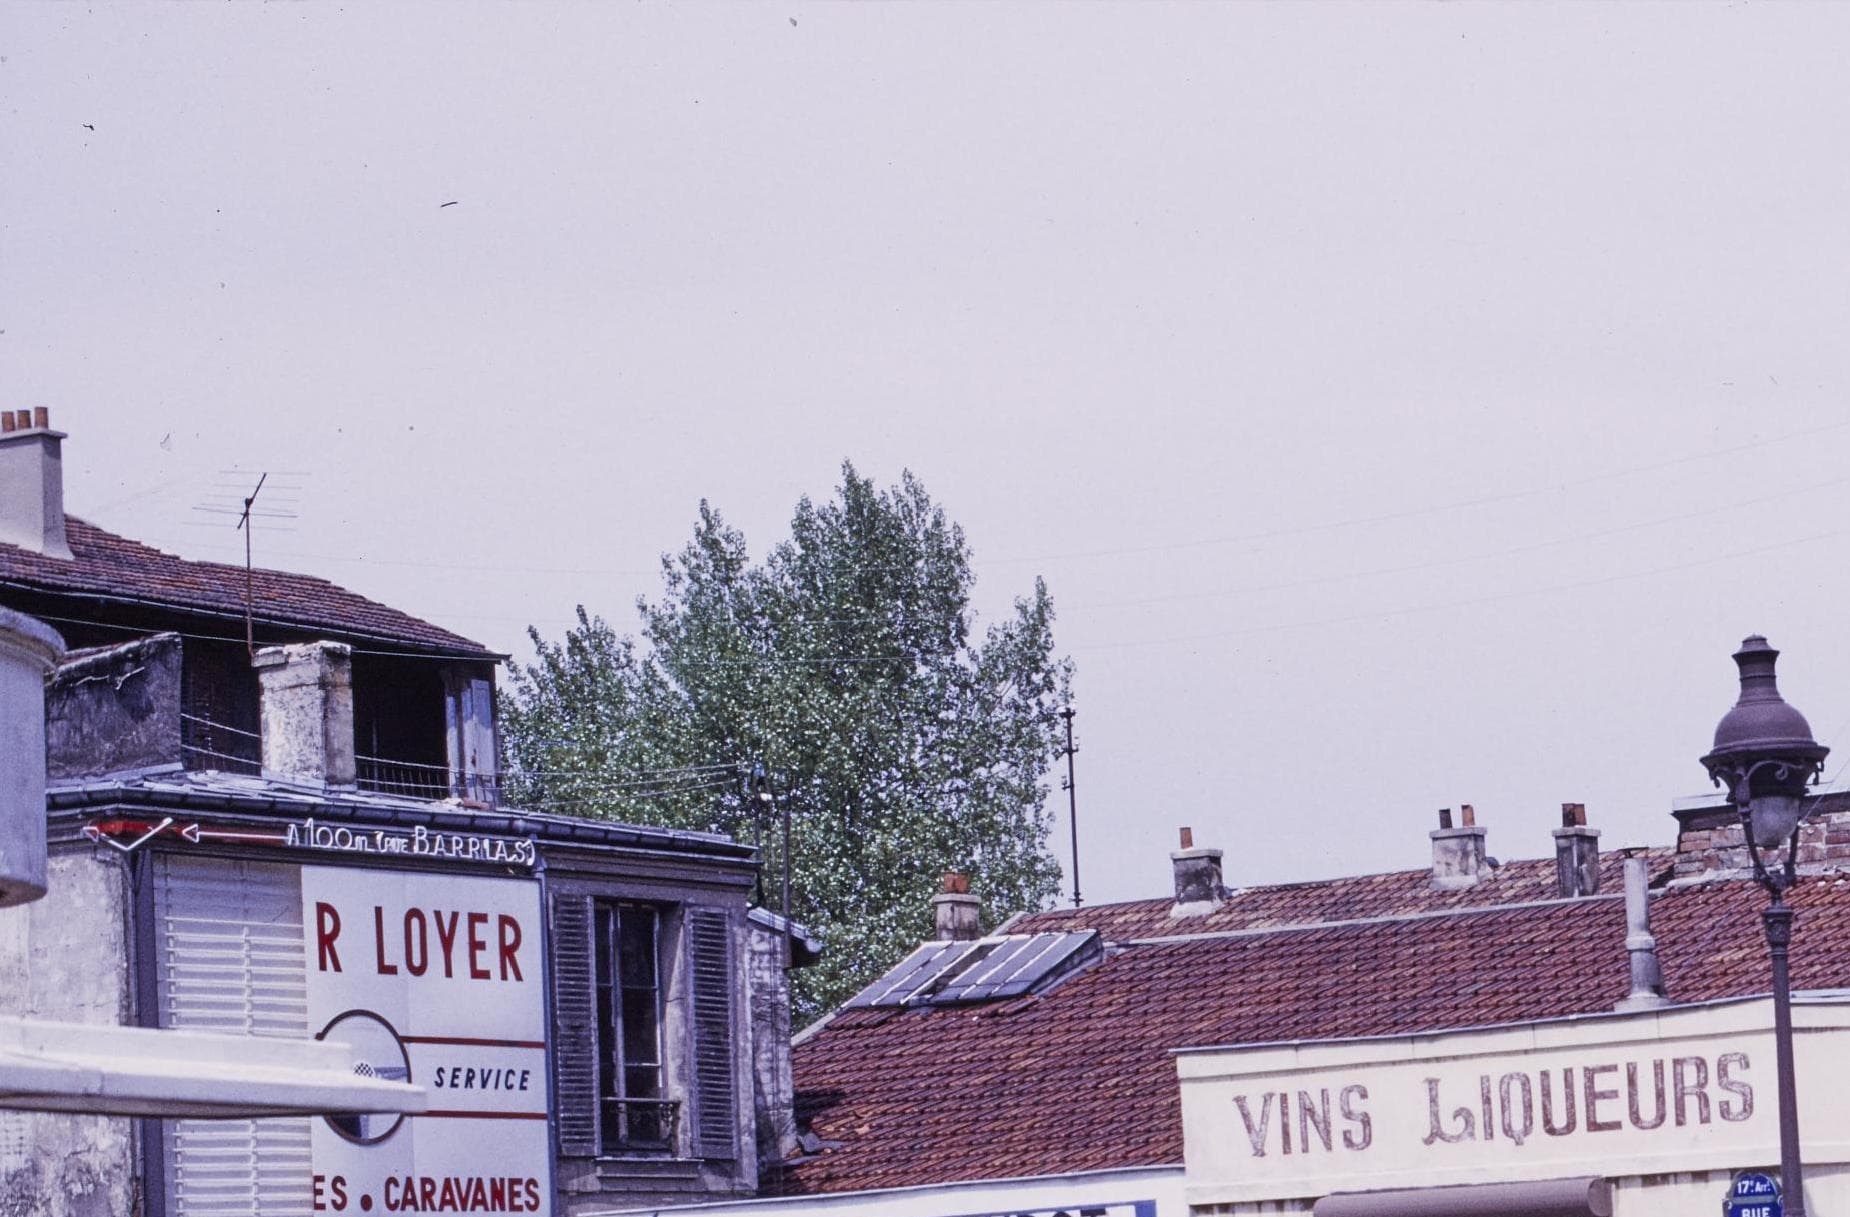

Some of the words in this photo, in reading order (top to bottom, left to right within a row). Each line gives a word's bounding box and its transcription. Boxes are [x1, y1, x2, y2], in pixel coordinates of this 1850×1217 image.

[374, 905, 524, 982] LOYER
[433, 1066, 531, 1091] SERVICE
[1233, 1083, 1372, 1158] VINS
[1421, 1051, 1755, 1147] LIQUEURS
[384, 1176, 540, 1213] CARAVANES
